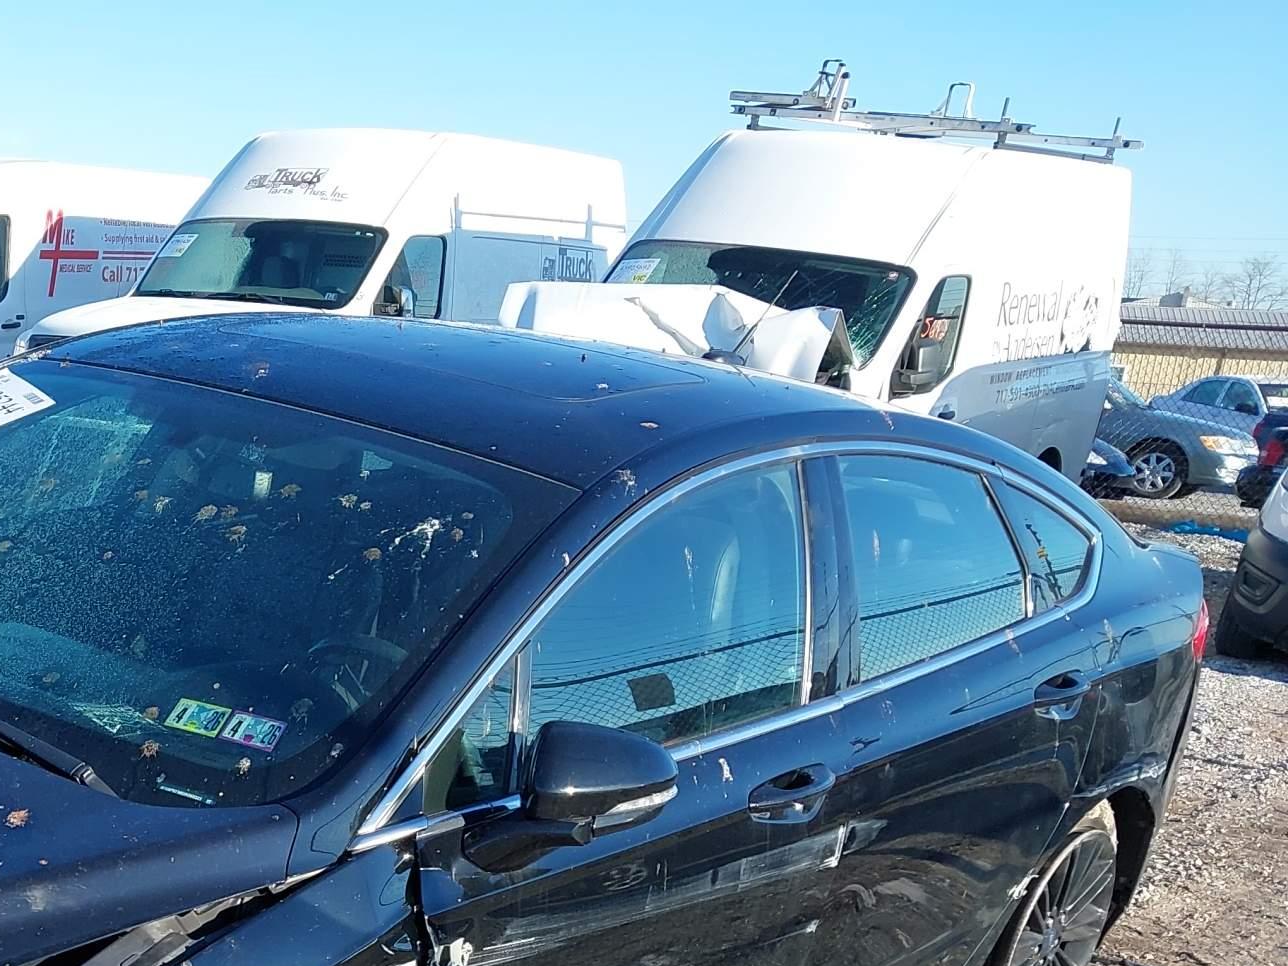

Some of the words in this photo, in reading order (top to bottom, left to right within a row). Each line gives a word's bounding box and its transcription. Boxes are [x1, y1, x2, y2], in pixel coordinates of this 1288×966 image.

[102, 266, 123, 282] Call
[997, 280, 1063, 327] Renewal
[173, 707, 189, 724] 4
[227, 720, 244, 738] 4
